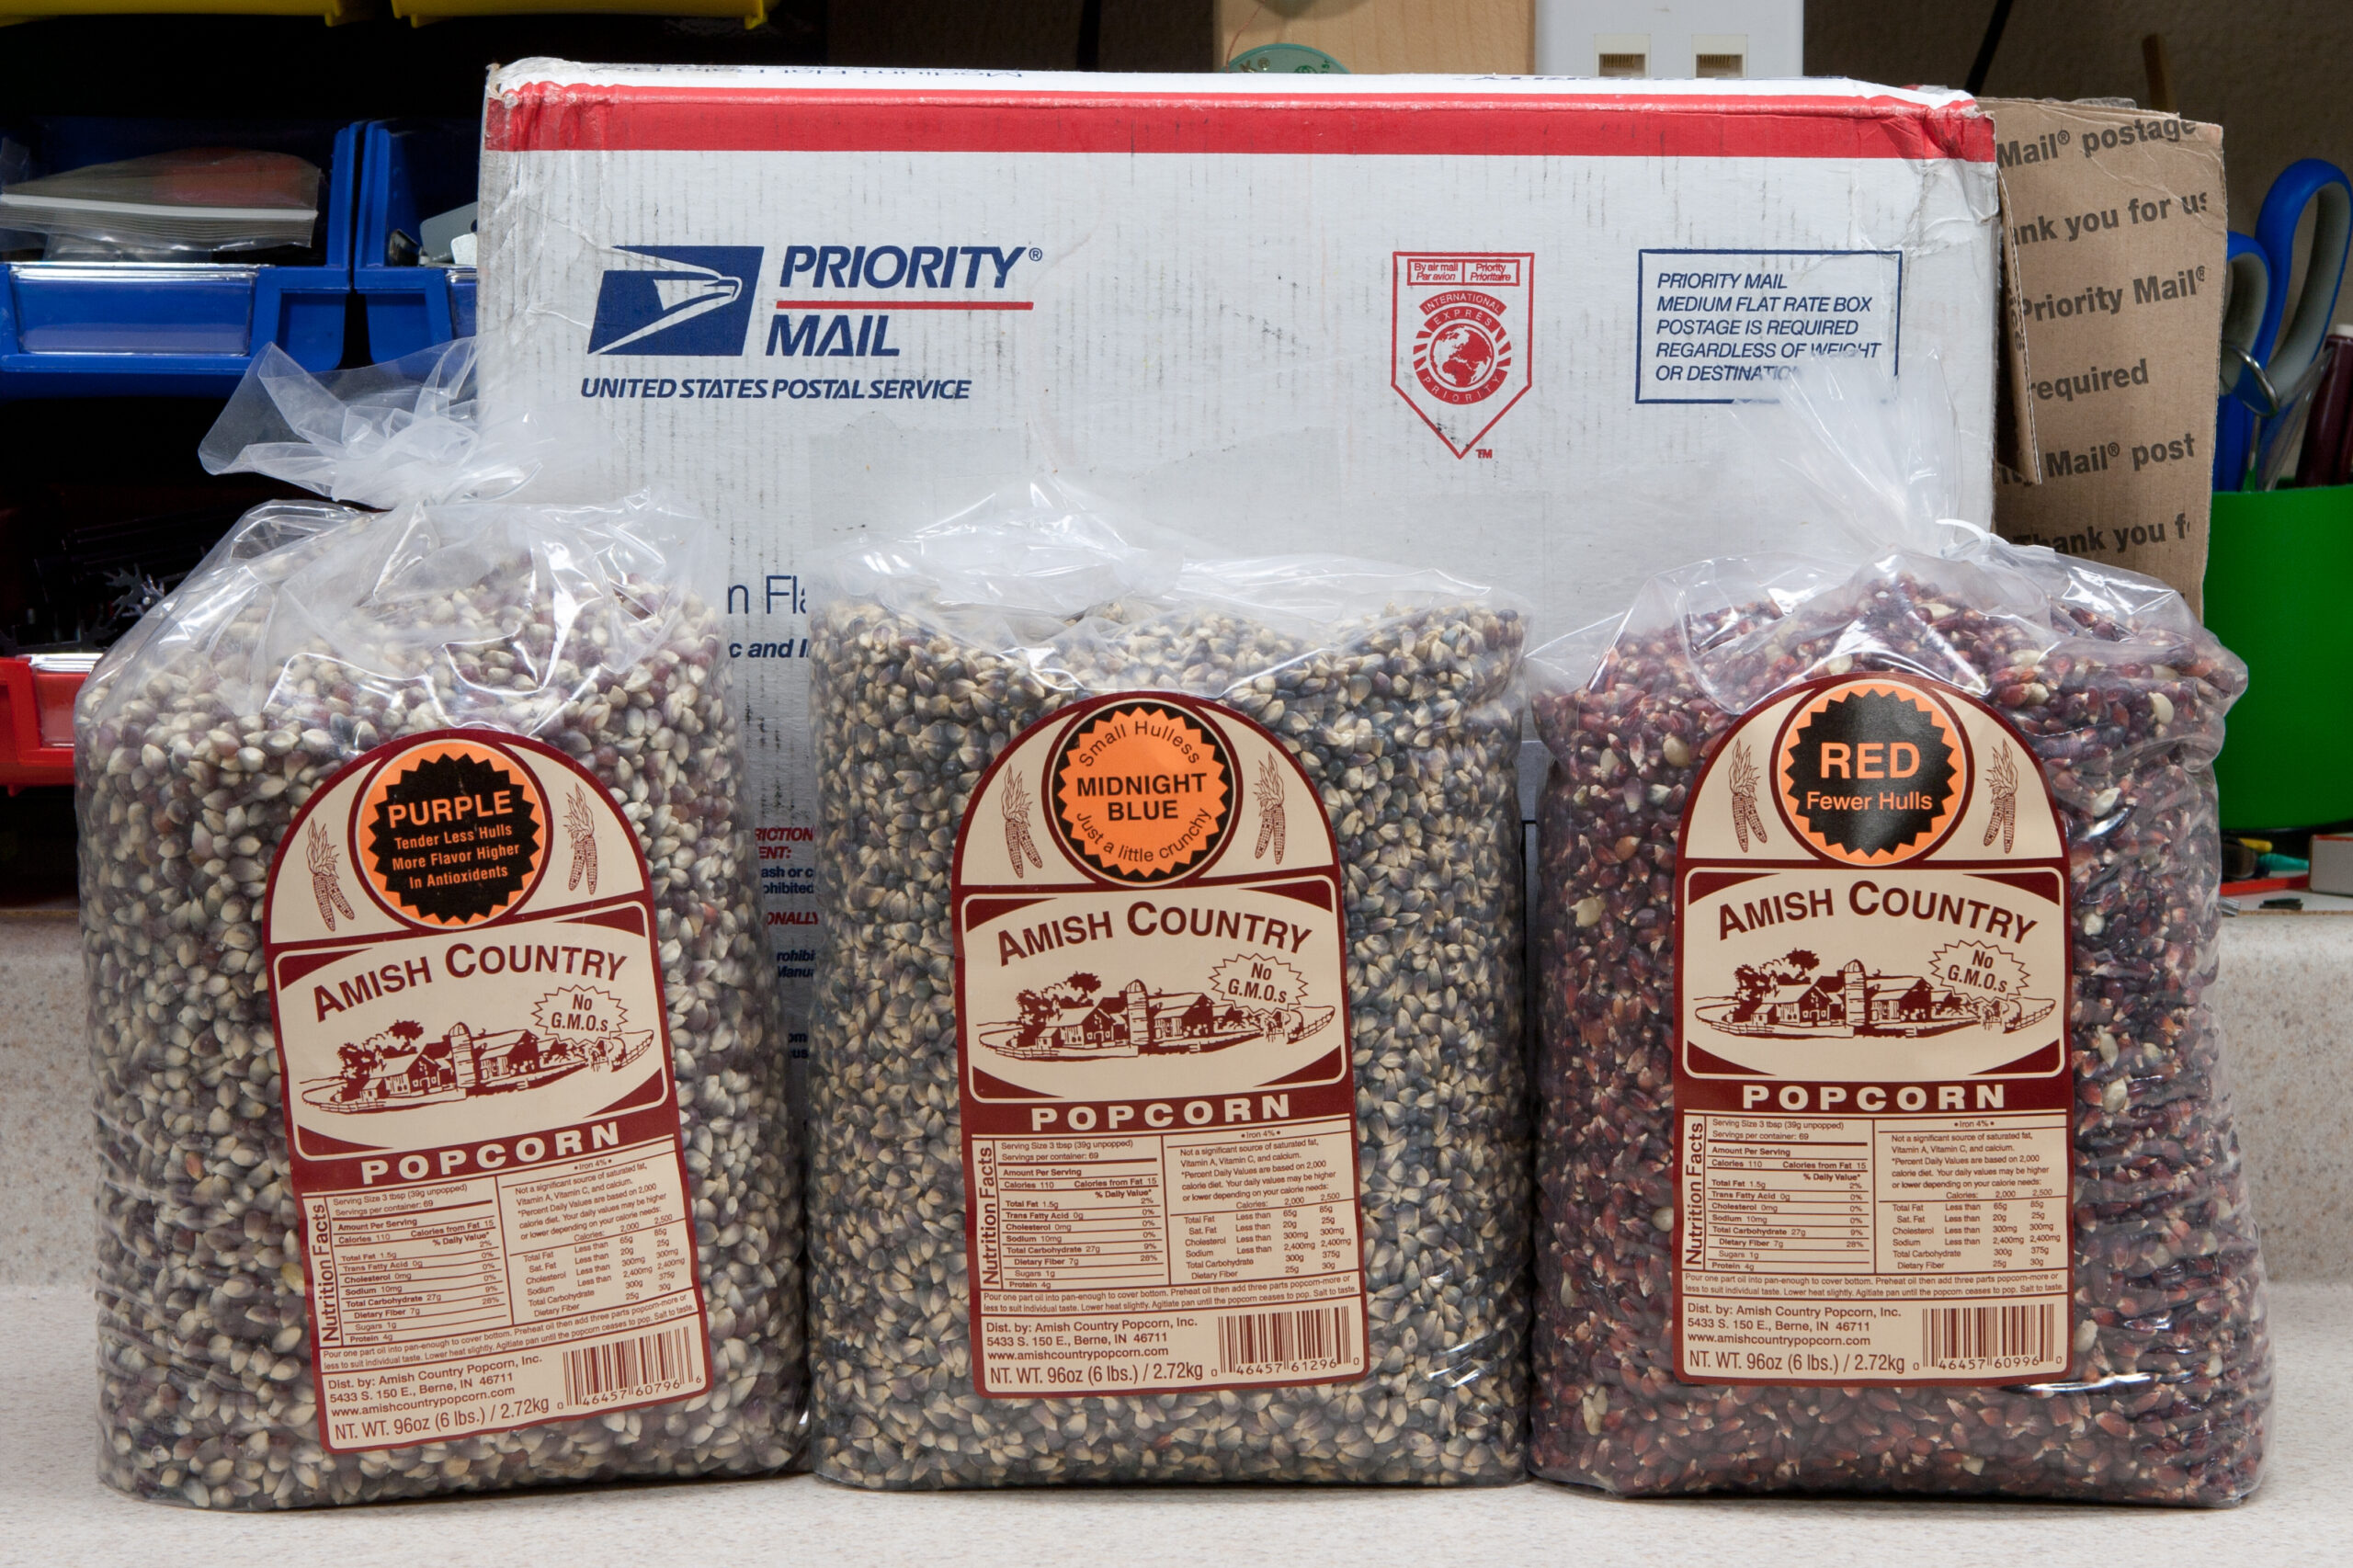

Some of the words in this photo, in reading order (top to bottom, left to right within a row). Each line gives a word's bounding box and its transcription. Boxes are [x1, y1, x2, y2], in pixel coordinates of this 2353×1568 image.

[2081, 119, 2197, 158] postage
[2065, 209, 2119, 242] you
[2128, 198, 2171, 224] for
[1415, 263, 1426, 272] By
[1427, 263, 1439, 271] air
[1440, 263, 1459, 271] mail
[1476, 263, 1506, 272] Priority
[1657, 272, 1741, 288] PRIORITY
[1744, 273, 1787, 289] MAIL
[1424, 292, 1500, 312] INTERNATIONAL
[1656, 296, 1732, 312] MEDIUM
[1735, 296, 1780, 312] FLAT
[1783, 296, 1830, 312] RATE
[1833, 296, 1871, 312] BOX
[766, 314, 900, 357] MAIL
[1656, 319, 1742, 335] POSTAGE
[1745, 320, 1762, 335] IS
[1767, 319, 1858, 335] REQUIRED
[1655, 342, 1776, 358] REGARDLESS
[1780, 342, 1806, 358] OF
[1655, 365, 1682, 381] OR
[581, 377, 676, 398] UNITED
[678, 378, 767, 399] STATES
[771, 379, 864, 399] POSTAL
[868, 378, 972, 399] SERVICE
[1423, 376, 1499, 403] PRIORITY
[2131, 433, 2195, 472] post
[2113, 523, 2166, 553] you
[747, 638, 794, 658] and
[1080, 723, 1127, 767] Small
[1135, 721, 1200, 764] Hulless
[1821, 742, 1920, 778] RED
[1076, 772, 1207, 796] MIDNIGHT
[388, 790, 512, 828] PURPLE
[1108, 800, 1177, 821] BLUE
[1807, 791, 1872, 811] Fewer
[1879, 791, 1933, 811] Hulls
[395, 833, 438, 850] Tender
[444, 829, 475, 846] Less
[479, 824, 512, 841] Hulls
[1076, 812, 1104, 846] Just
[1104, 841, 1114, 855] a
[1118, 844, 1154, 862] little
[1159, 808, 1211, 859] crunchy
[392, 857, 426, 870] More
[430, 851, 472, 865] Flavor
[476, 844, 518, 860] Higher
[409, 876, 422, 889] In
[426, 865, 507, 887] Antioxidents
[788, 868, 803, 878] or
[1718, 888, 1834, 941] AMISH
[1848, 881, 2038, 945] COUNTRY
[997, 911, 1113, 967] AMISH
[1127, 902, 1313, 954] COUNTRY
[1251, 962, 1272, 980] No
[1972, 949, 1994, 968] No
[313, 957, 432, 1022] AMISH
[445, 943, 627, 982] COUNTRY
[1228, 981, 1287, 1004] G.M.O.s
[1948, 966, 2007, 994] G.M.O.s
[573, 994, 593, 1011] No
[551, 1015, 608, 1032] G.M.O.s
[1743, 1084, 2004, 1112] POPCORN
[1031, 1095, 1290, 1131] POPCORN
[1712, 1118, 1739, 1128] Serving
[1758, 1119, 1764, 1128] 3
[1766, 1120, 1782, 1129] tbsp
[1784, 1119, 1801, 1130] (39g
[1802, 1119, 1844, 1130] unpopped)
[1913, 1134, 1949, 1143] significant
[1986, 1131, 2019, 1140] saturated
[361, 1121, 620, 1185] POPCORN
[1687, 1123, 1703, 1178] Facts
[979, 1147, 996, 1198] Facts
[1003, 1169, 1033, 1178] Amount
[1051, 1168, 1081, 1177] Serving
[313, 1204, 331, 1254] Facts
[1685, 1181, 1703, 1266] Nutrition
[981, 1202, 1000, 1285] Nutrition
[320, 1256, 341, 1344] Nutrition
[987, 1347, 1168, 1360] www.amishcountrypopcorn.com
[1236, 1361, 1282, 1375] 46457
[1291, 1358, 1337, 1372] 61296
[1689, 1349, 1711, 1367] NT.
[1715, 1351, 1741, 1369] WT.
[1746, 1352, 1782, 1369] 96oz
[1788, 1353, 1802, 1373] (6
[1807, 1354, 1838, 1374] lbs.)
[1854, 1353, 1904, 1374] 2.72kg
[1938, 1358, 1985, 1370] 46457
[1994, 1356, 2040, 1369] 60996
[327, 1379, 354, 1389] Dist.
[357, 1378, 375, 1388] by:
[378, 1372, 415, 1384] Amish
[417, 1368, 463, 1380] Country
[466, 1359, 517, 1373] Popcorn,
[521, 1355, 541, 1365] Inc.
[990, 1367, 1011, 1383] NT.
[1016, 1367, 1042, 1383] WT.
[1047, 1366, 1083, 1383] 96oz
[1087, 1365, 1102, 1385] (6
[1107, 1364, 1138, 1383] lbs.)
[1153, 1361, 1202, 1381] 2.72kg
[329, 1392, 358, 1403] 5433
[360, 1390, 372, 1401] S.
[376, 1388, 397, 1399] 150
[400, 1386, 415, 1396] E.,
[418, 1382, 456, 1393] Berne,
[459, 1379, 472, 1389] IN
[479, 1373, 513, 1385] 46711
[582, 1390, 628, 1407] 46457
[635, 1380, 681, 1397] 60796
[335, 1423, 358, 1439] NT.
[361, 1419, 389, 1437] WT.
[393, 1416, 430, 1434] 96oz
[435, 1412, 449, 1430] (6
[453, 1406, 484, 1426] lbs.)
[500, 1397, 549, 1418] 2.72kg
